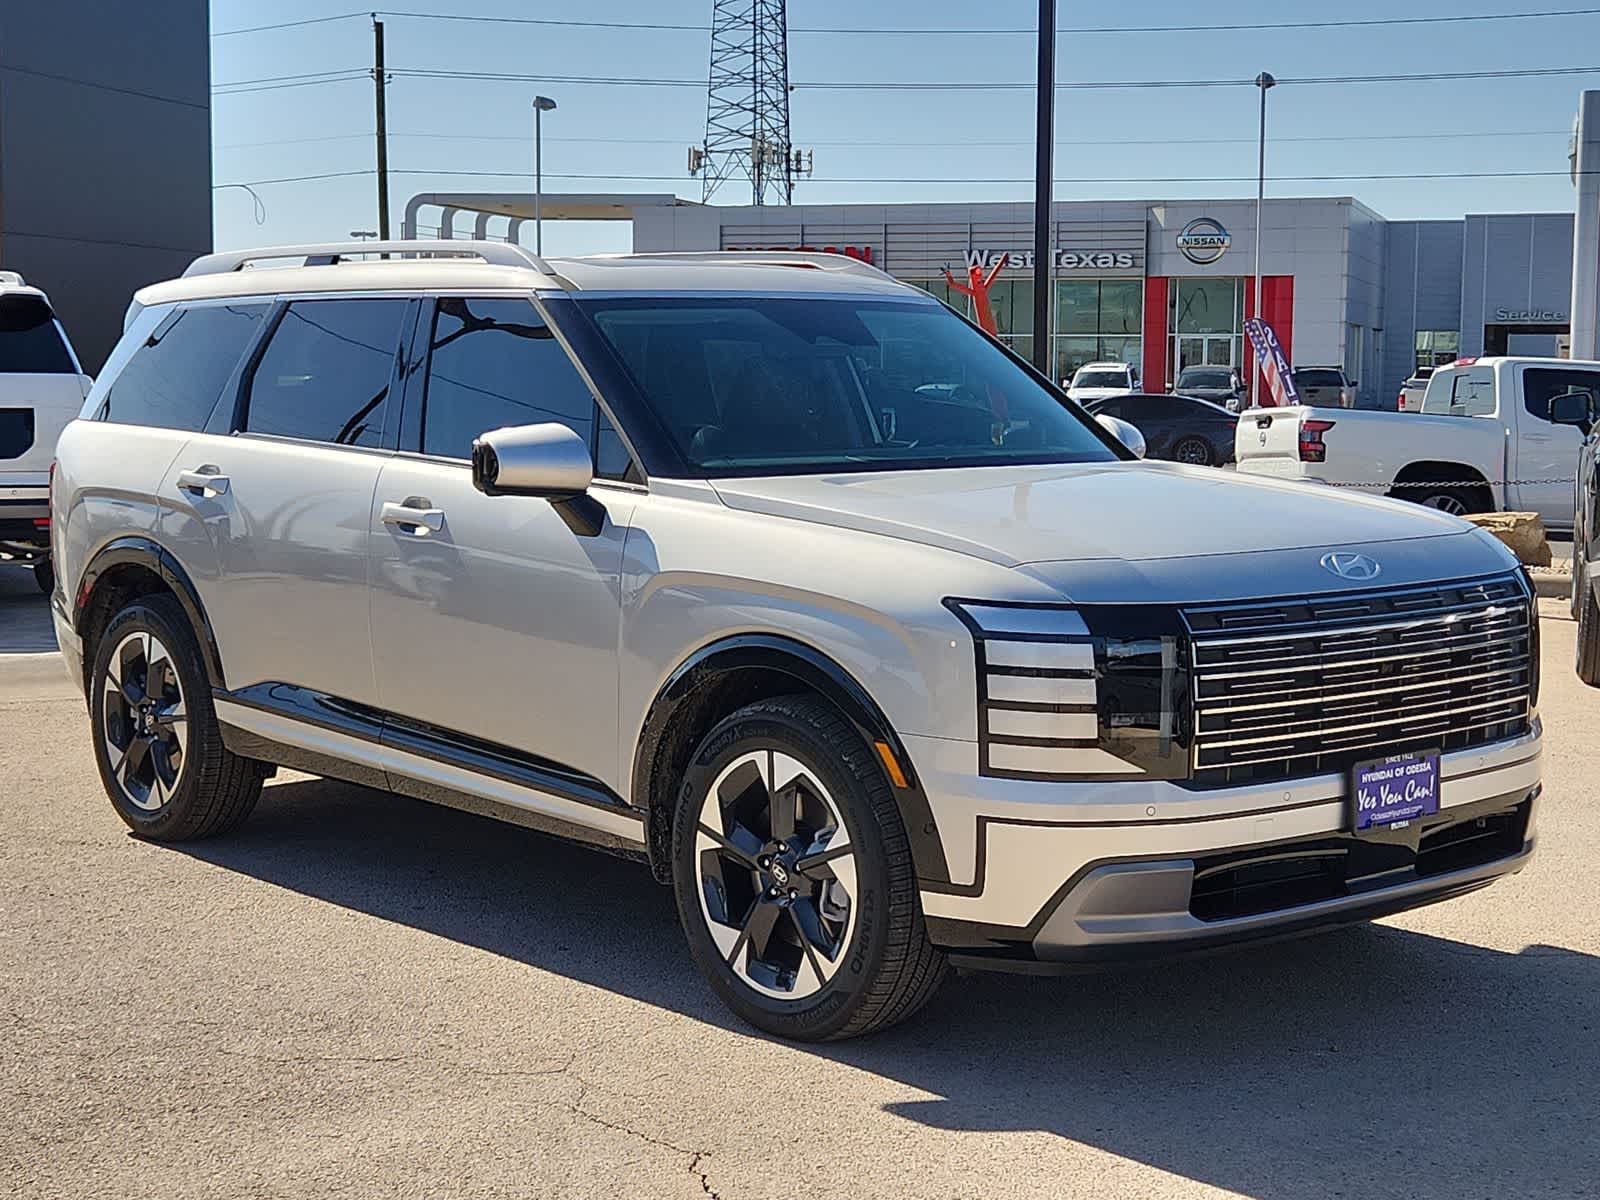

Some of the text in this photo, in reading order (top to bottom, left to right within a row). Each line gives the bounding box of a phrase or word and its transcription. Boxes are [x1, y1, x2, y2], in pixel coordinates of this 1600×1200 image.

[1182, 237, 1225, 246] NISSAN
[963, 249, 1133, 269] West Texas
[1496, 307, 1562, 321] Service
[1362, 762, 1432, 783] HYUNDAI OF ODESSA
[1358, 775, 1434, 811] Yes You Can!
